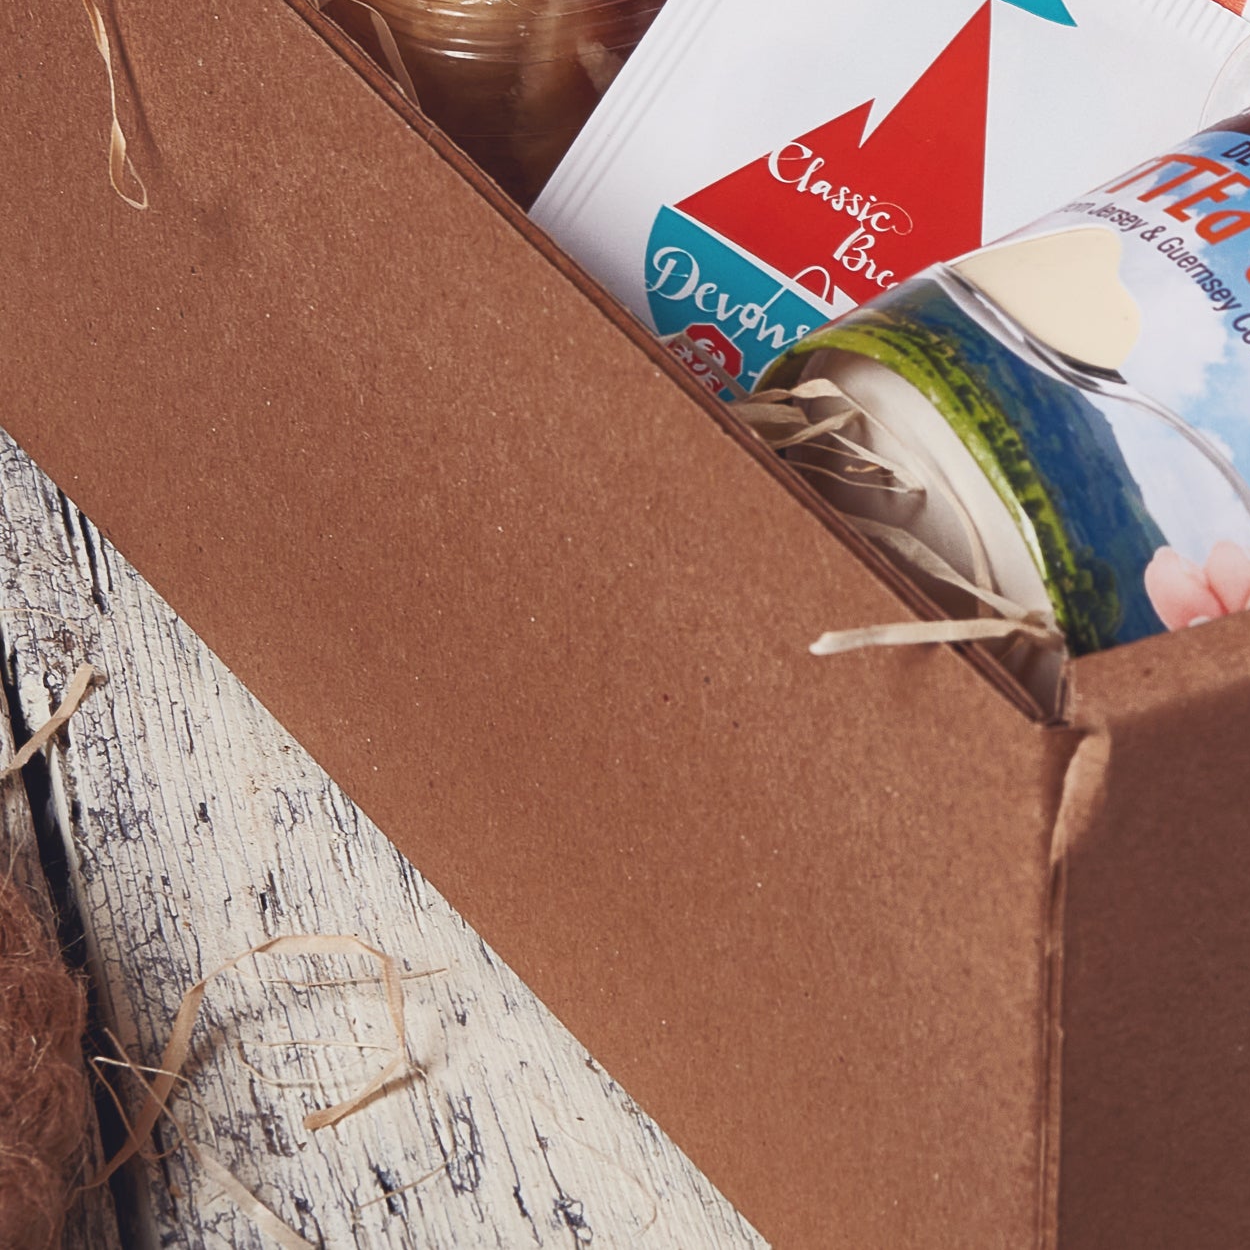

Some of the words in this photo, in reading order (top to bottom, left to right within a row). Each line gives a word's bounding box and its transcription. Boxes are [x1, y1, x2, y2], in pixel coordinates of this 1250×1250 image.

[766, 141, 913, 235] Classic
[1087, 202, 1149, 232] Jersey
[1140, 225, 1167, 242] &
[1156, 237, 1241, 311] Guernsey
